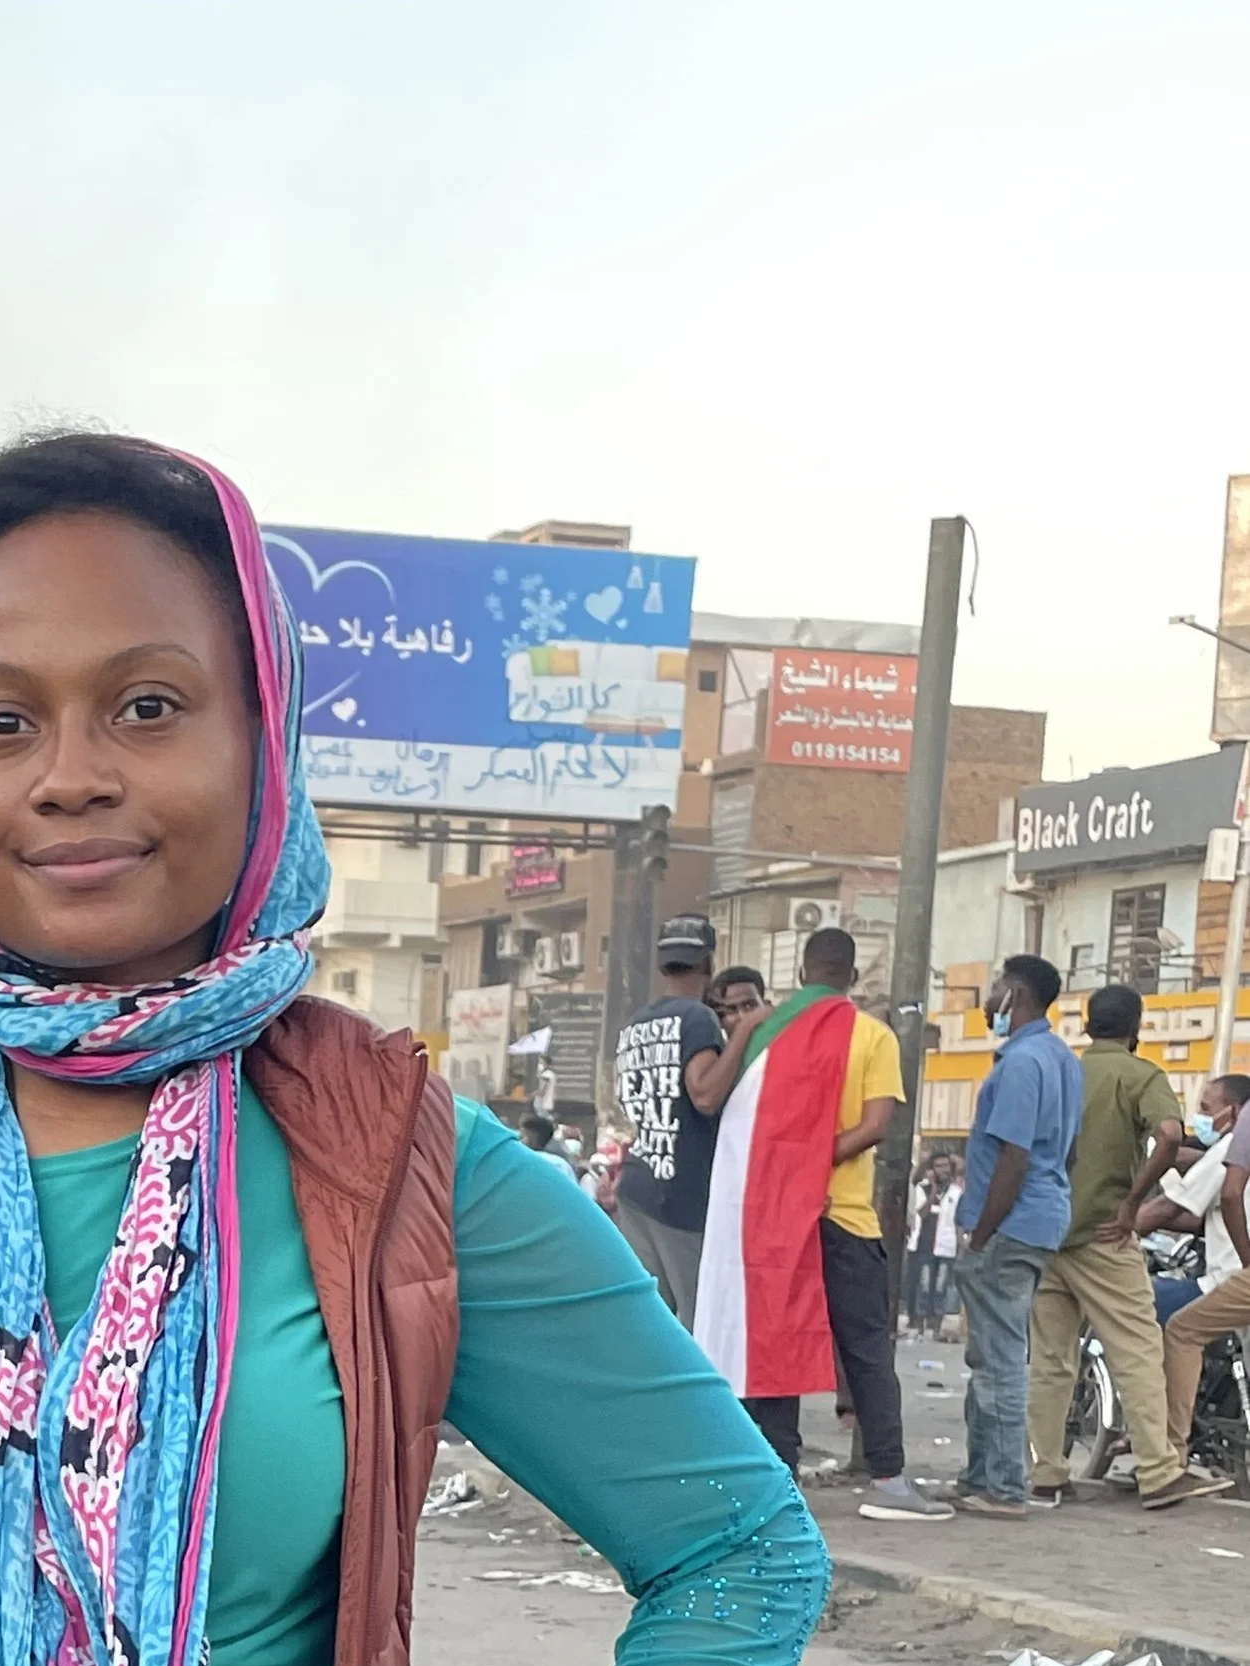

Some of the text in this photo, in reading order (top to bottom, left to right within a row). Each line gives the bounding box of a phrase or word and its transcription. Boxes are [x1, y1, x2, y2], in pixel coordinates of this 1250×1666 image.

[299, 613, 474, 665] رفاهية بلا حد
[780, 657, 898, 701] شيماء الشيخ
[876, 707, 914, 737] عناية
[1017, 790, 1155, 853] Black Craft
